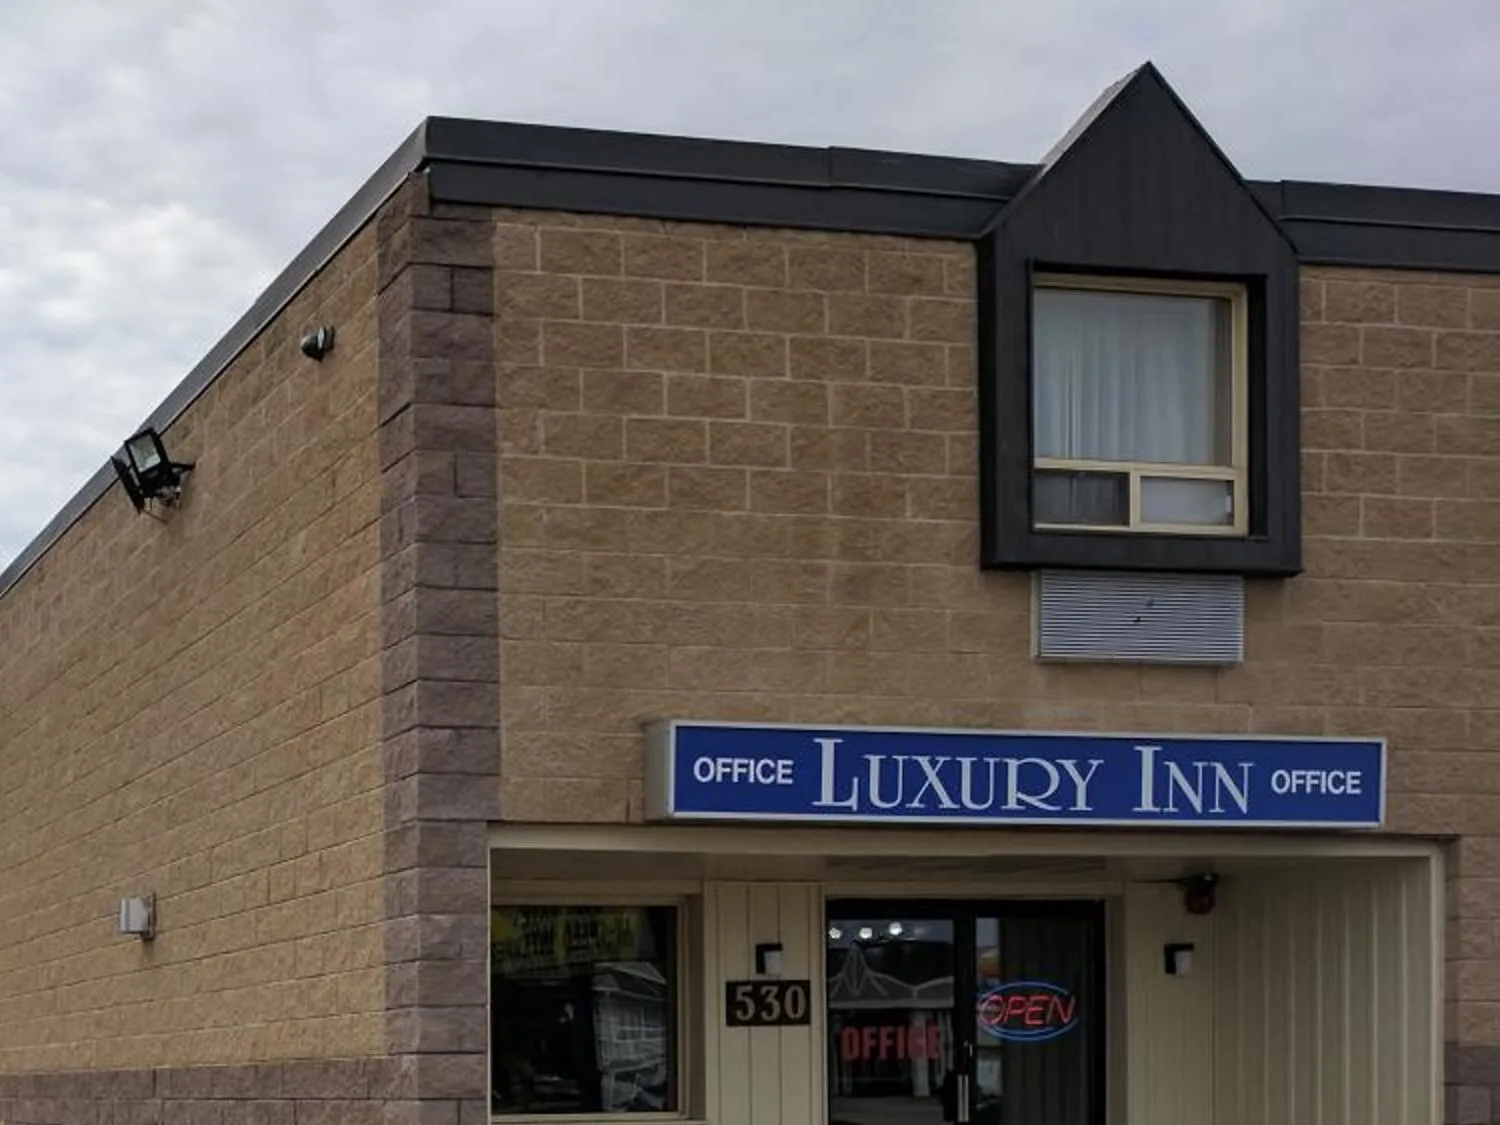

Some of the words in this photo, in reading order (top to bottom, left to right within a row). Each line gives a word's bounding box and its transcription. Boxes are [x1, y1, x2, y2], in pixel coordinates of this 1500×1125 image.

[693, 757, 795, 785] OFFICE
[812, 737, 1104, 812] LUXURY
[1133, 745, 1255, 815] INN
[1271, 769, 1363, 795] OFFICE
[734, 985, 807, 1021] 530
[979, 995, 1077, 1026] OPEN
[840, 1024, 942, 1062] OFFICE
